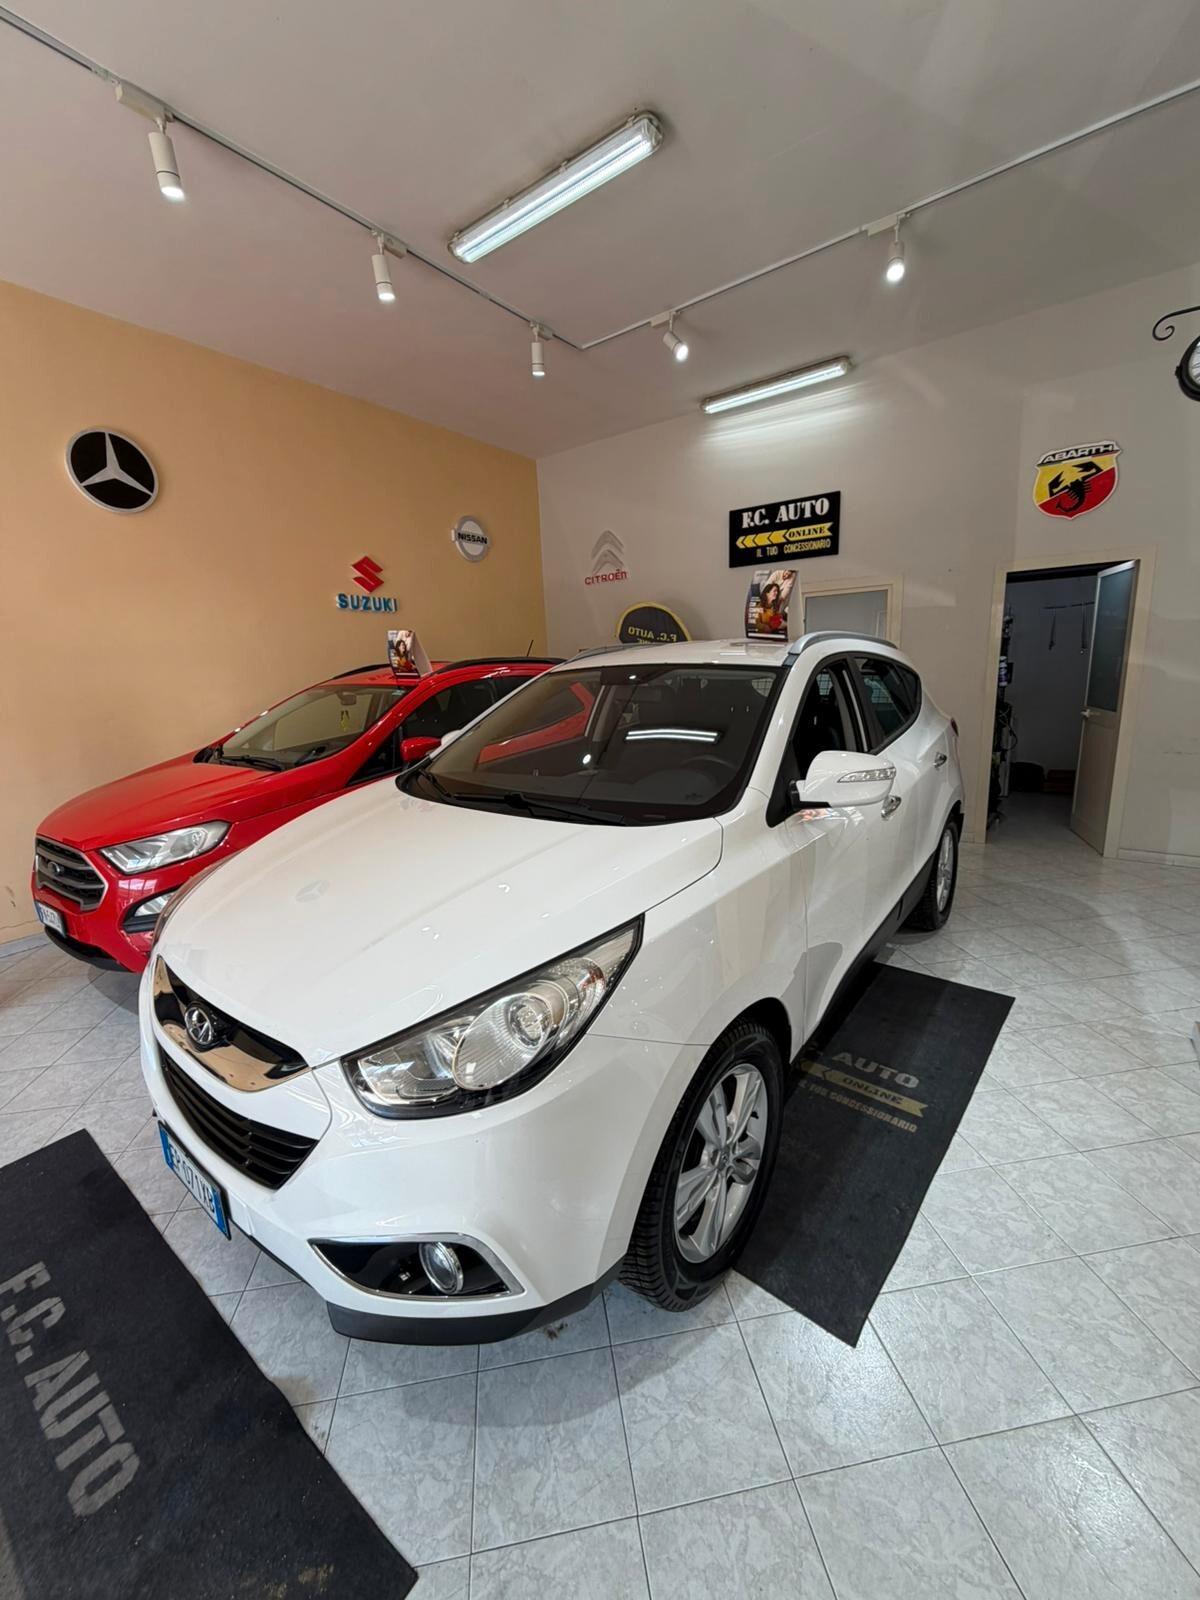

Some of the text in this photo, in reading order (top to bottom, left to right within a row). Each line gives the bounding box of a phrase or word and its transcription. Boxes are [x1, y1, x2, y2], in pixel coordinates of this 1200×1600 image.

[1043, 444, 1113, 463] ABARTH
[742, 498, 830, 528] F.C. AUTO
[457, 532, 488, 545] NISSAN
[788, 526, 825, 538] ONLINE
[756, 539, 831, 557] IL TUO CONCESSIONARIO
[336, 592, 399, 612] SUZUKI
[832, 1052, 920, 1088] AUTO
[843, 1077, 905, 1105] ONLINE
[829, 1091, 918, 1133] CONCESSIONARIO
[0, 1261, 141, 1517] F.C. AUTO
